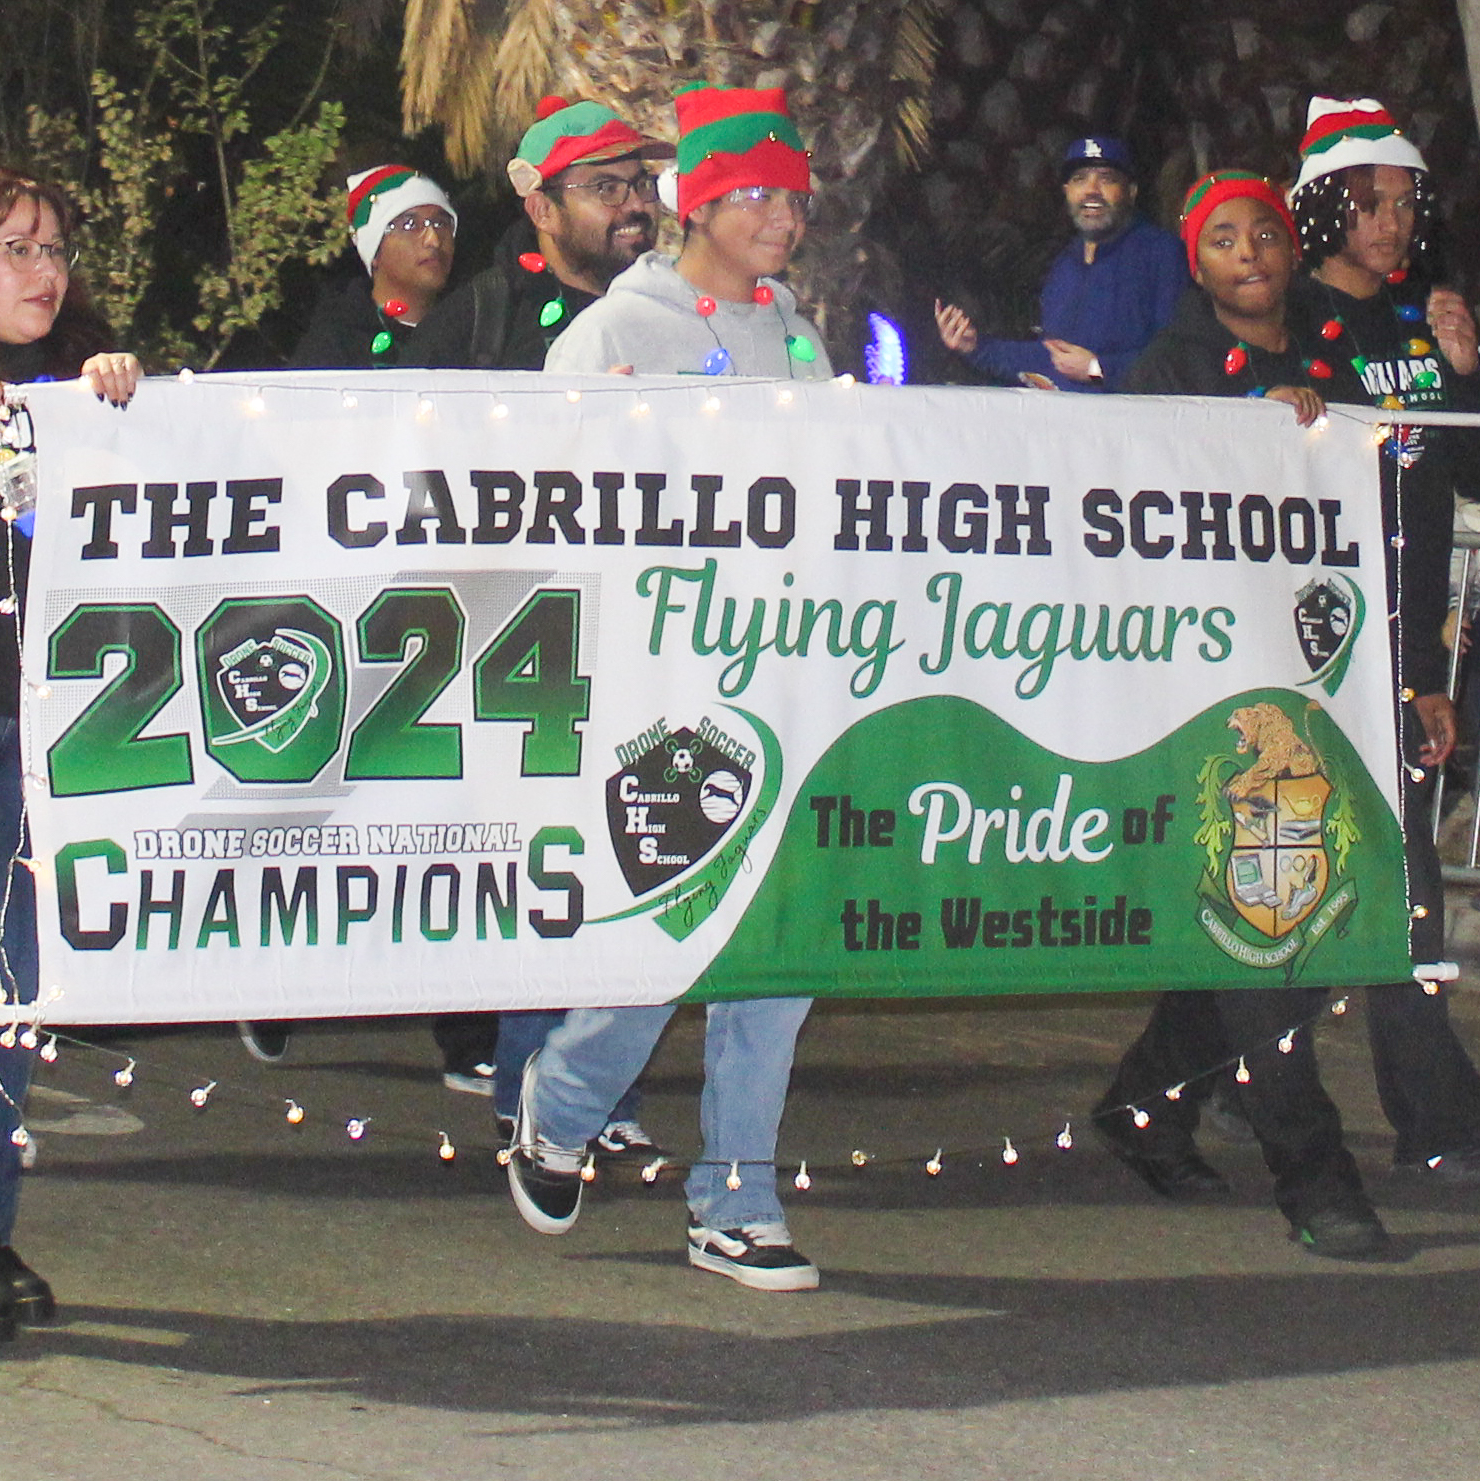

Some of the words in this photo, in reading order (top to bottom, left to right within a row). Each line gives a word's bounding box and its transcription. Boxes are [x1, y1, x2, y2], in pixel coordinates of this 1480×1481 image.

[71, 477, 283, 560] THE
[326, 470, 796, 550] CABRILLO
[833, 479, 1052, 557] HIGH
[1082, 488, 1361, 568] SCHOOL
[635, 557, 906, 699] Flying
[919, 571, 1236, 700] Jaguars
[46, 586, 592, 799] 2024
[613, 715, 673, 769] DRONE
[695, 715, 757, 773] SOCCER
[619, 774, 681, 804] CABRILLO
[134, 827, 246, 860] DRONE
[250, 824, 361, 858] SOCCER
[367, 822, 522, 856] NATIONAL
[625, 805, 667, 835] HIGH
[809, 794, 897, 848] The
[908, 773, 1114, 865] Pride
[1122, 794, 1177, 846] of
[638, 835, 691, 865] SCHOOL
[54, 825, 586, 951] CHAMPIONS
[840, 898, 923, 952] the
[940, 894, 1154, 950] Westside
[1201, 909, 1239, 954] CABRILLO
[1237, 946, 1264, 964] HIGH
[1264, 938, 1299, 964] SCHOOL
